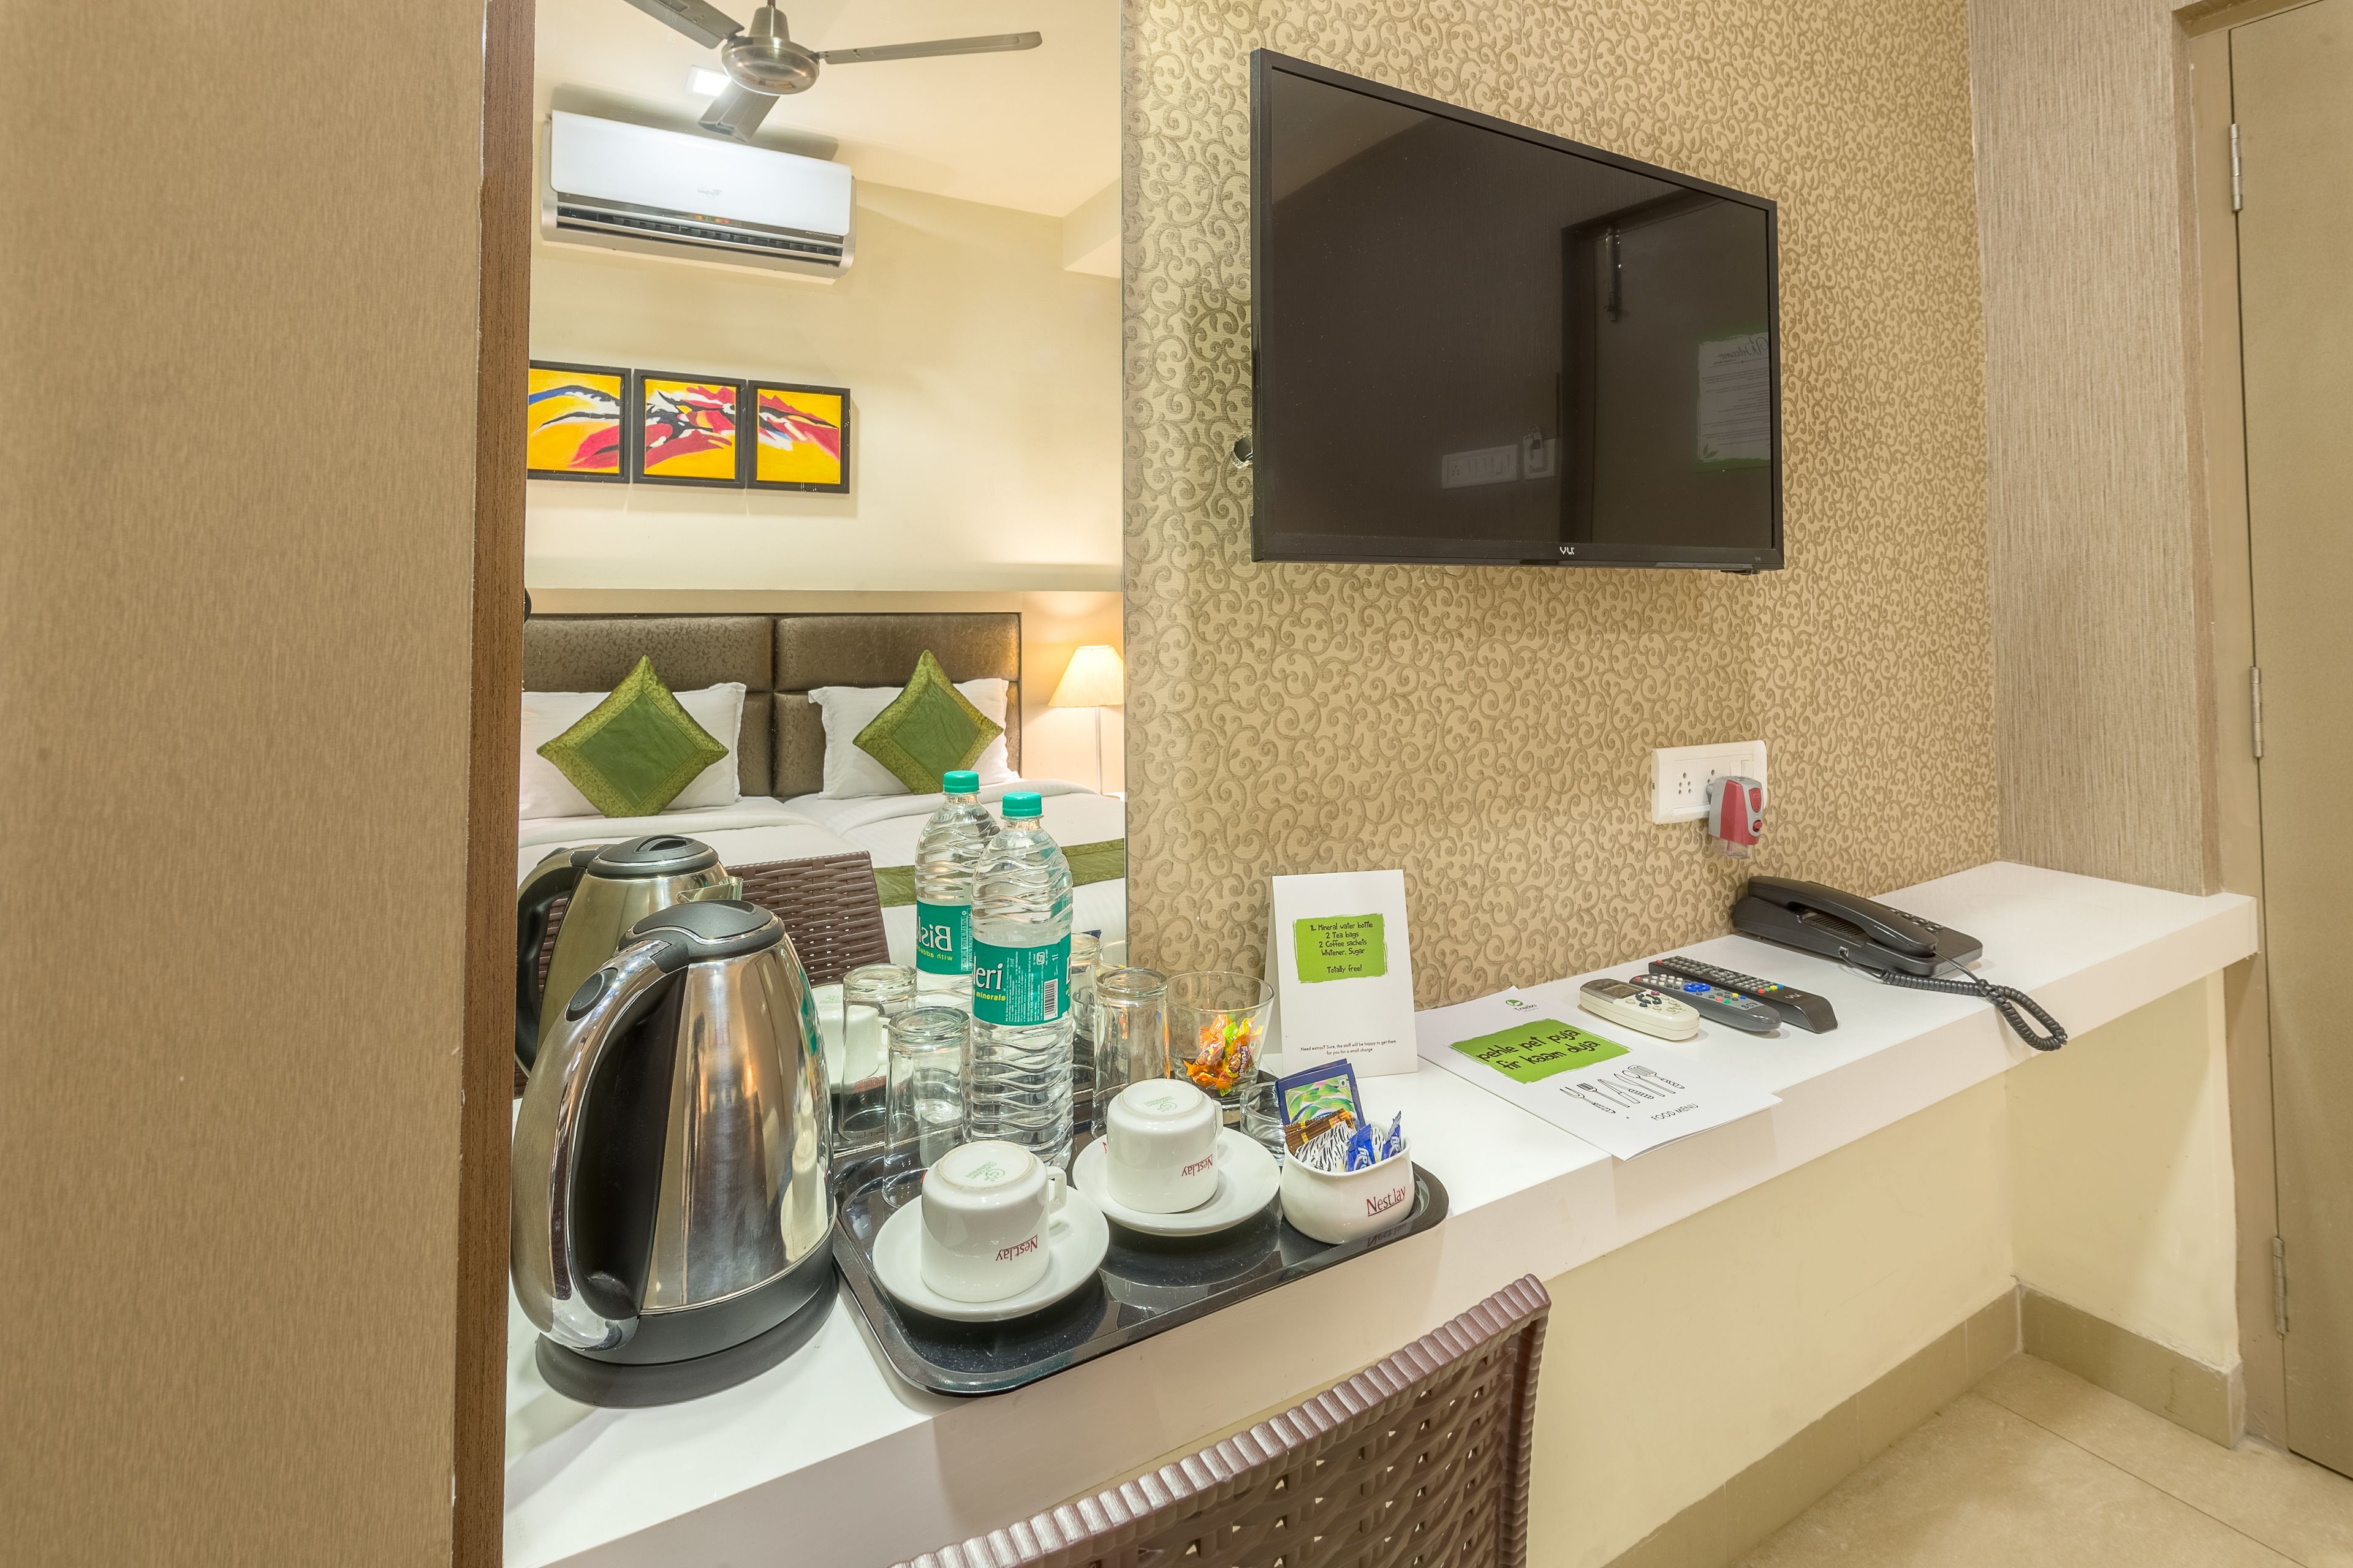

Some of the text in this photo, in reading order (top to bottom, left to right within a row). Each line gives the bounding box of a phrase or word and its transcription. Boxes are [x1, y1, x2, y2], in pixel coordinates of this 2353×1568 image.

[976, 991, 1006, 1001] minerals
[1476, 1029, 1581, 1062] pehle pet puja
[1496, 1040, 1601, 1070] fir kaam duja
[1650, 1103, 1699, 1121] FOOD MENU
